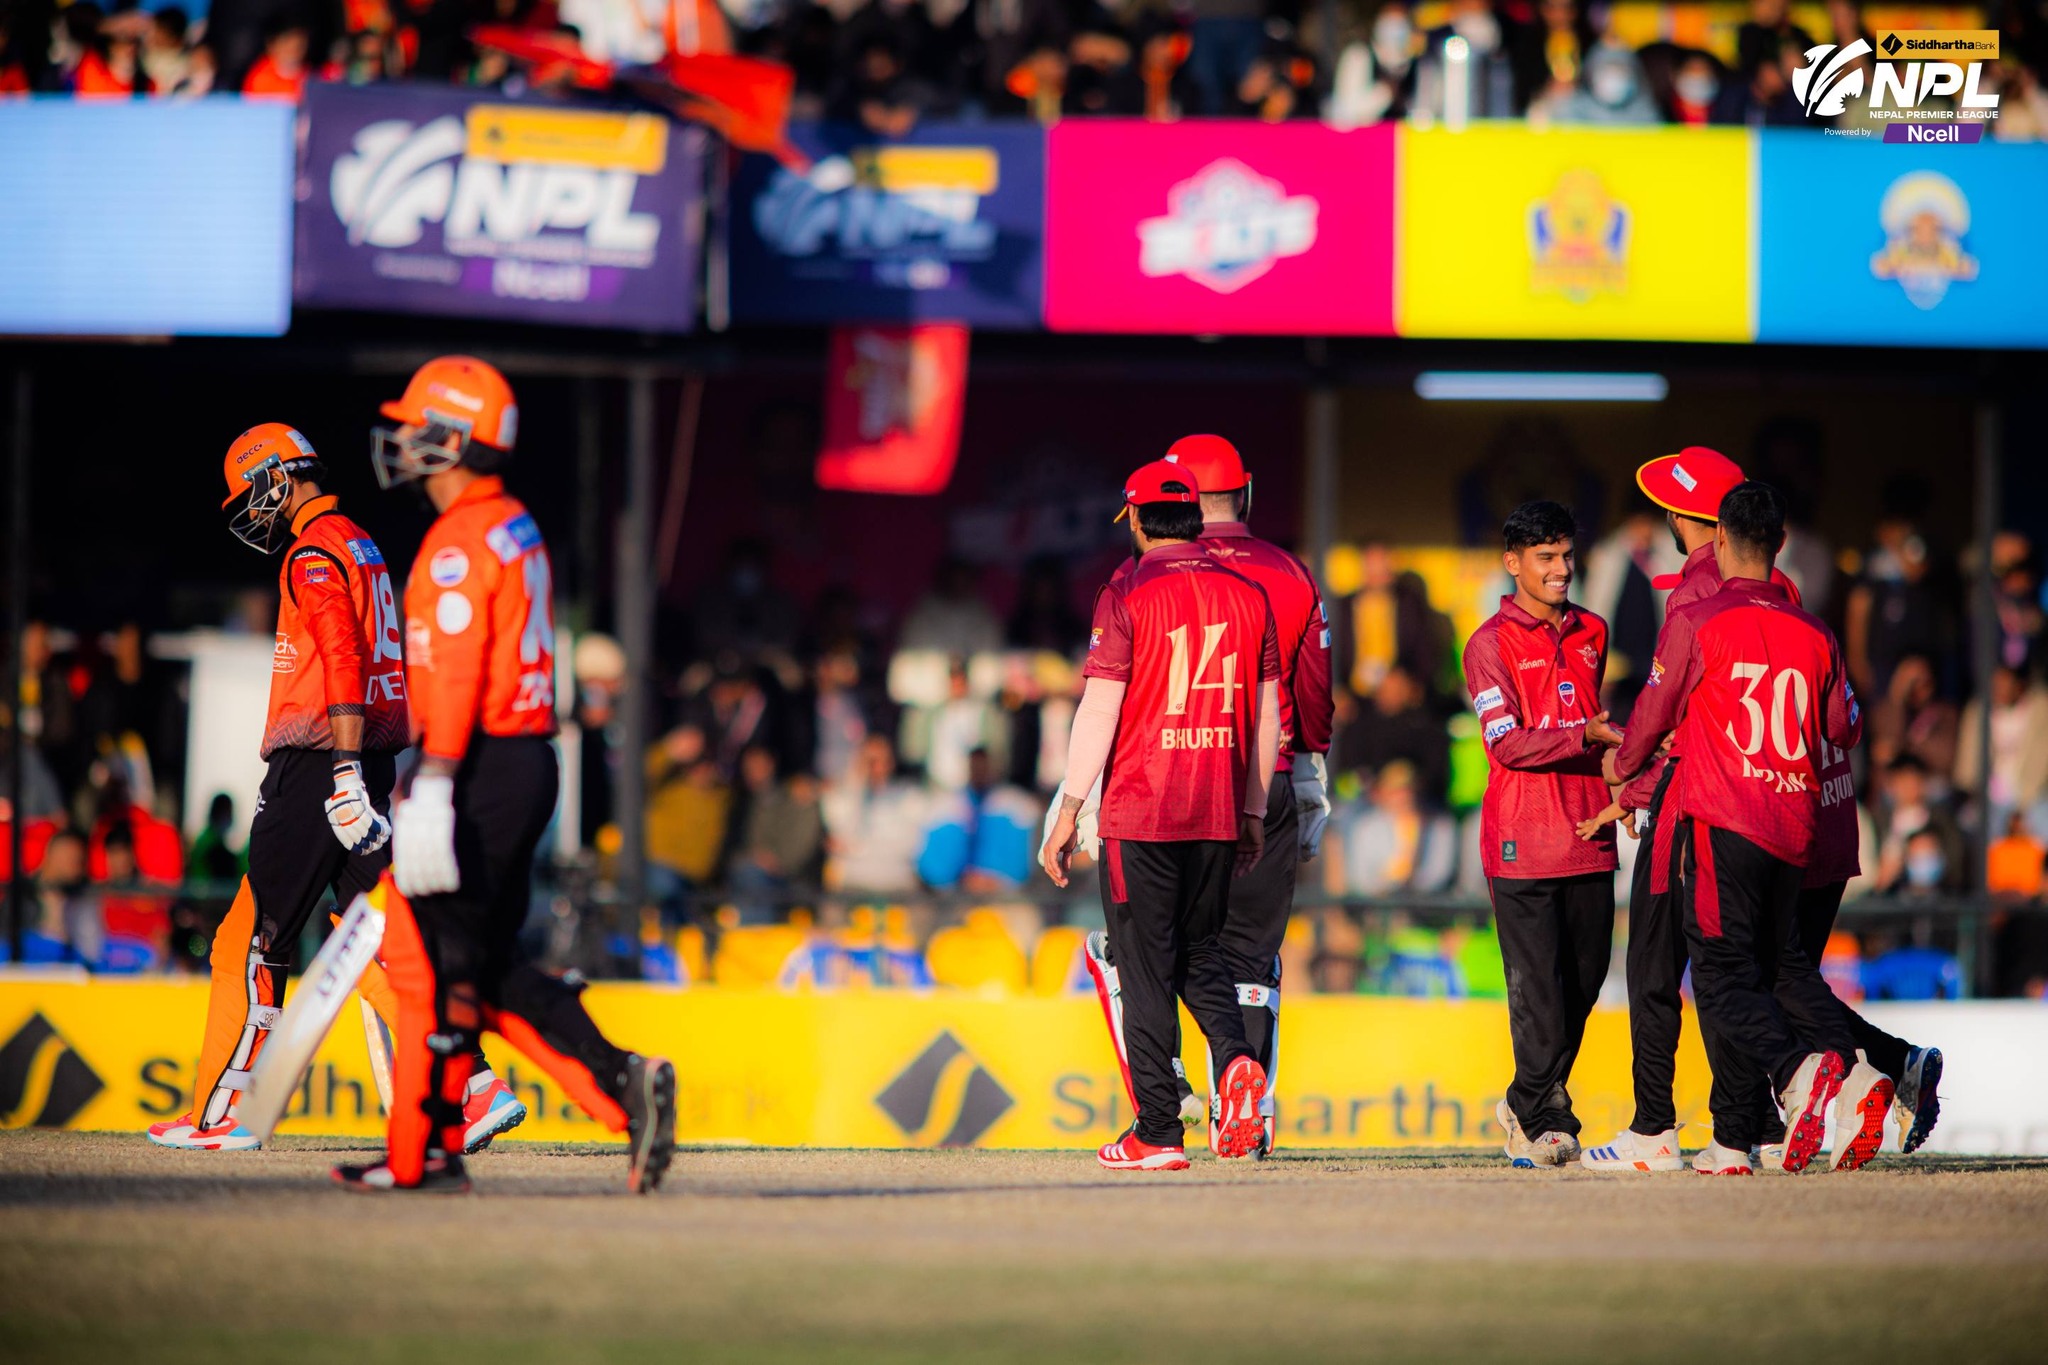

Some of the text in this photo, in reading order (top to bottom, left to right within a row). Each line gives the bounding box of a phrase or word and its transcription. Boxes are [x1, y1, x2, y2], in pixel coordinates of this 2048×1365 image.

[443, 158, 661, 251] NPL
[371, 572, 402, 663] 18
[365, 671, 409, 706] DE
[1164, 621, 1243, 716] 14
[1725, 661, 1809, 761] 30
